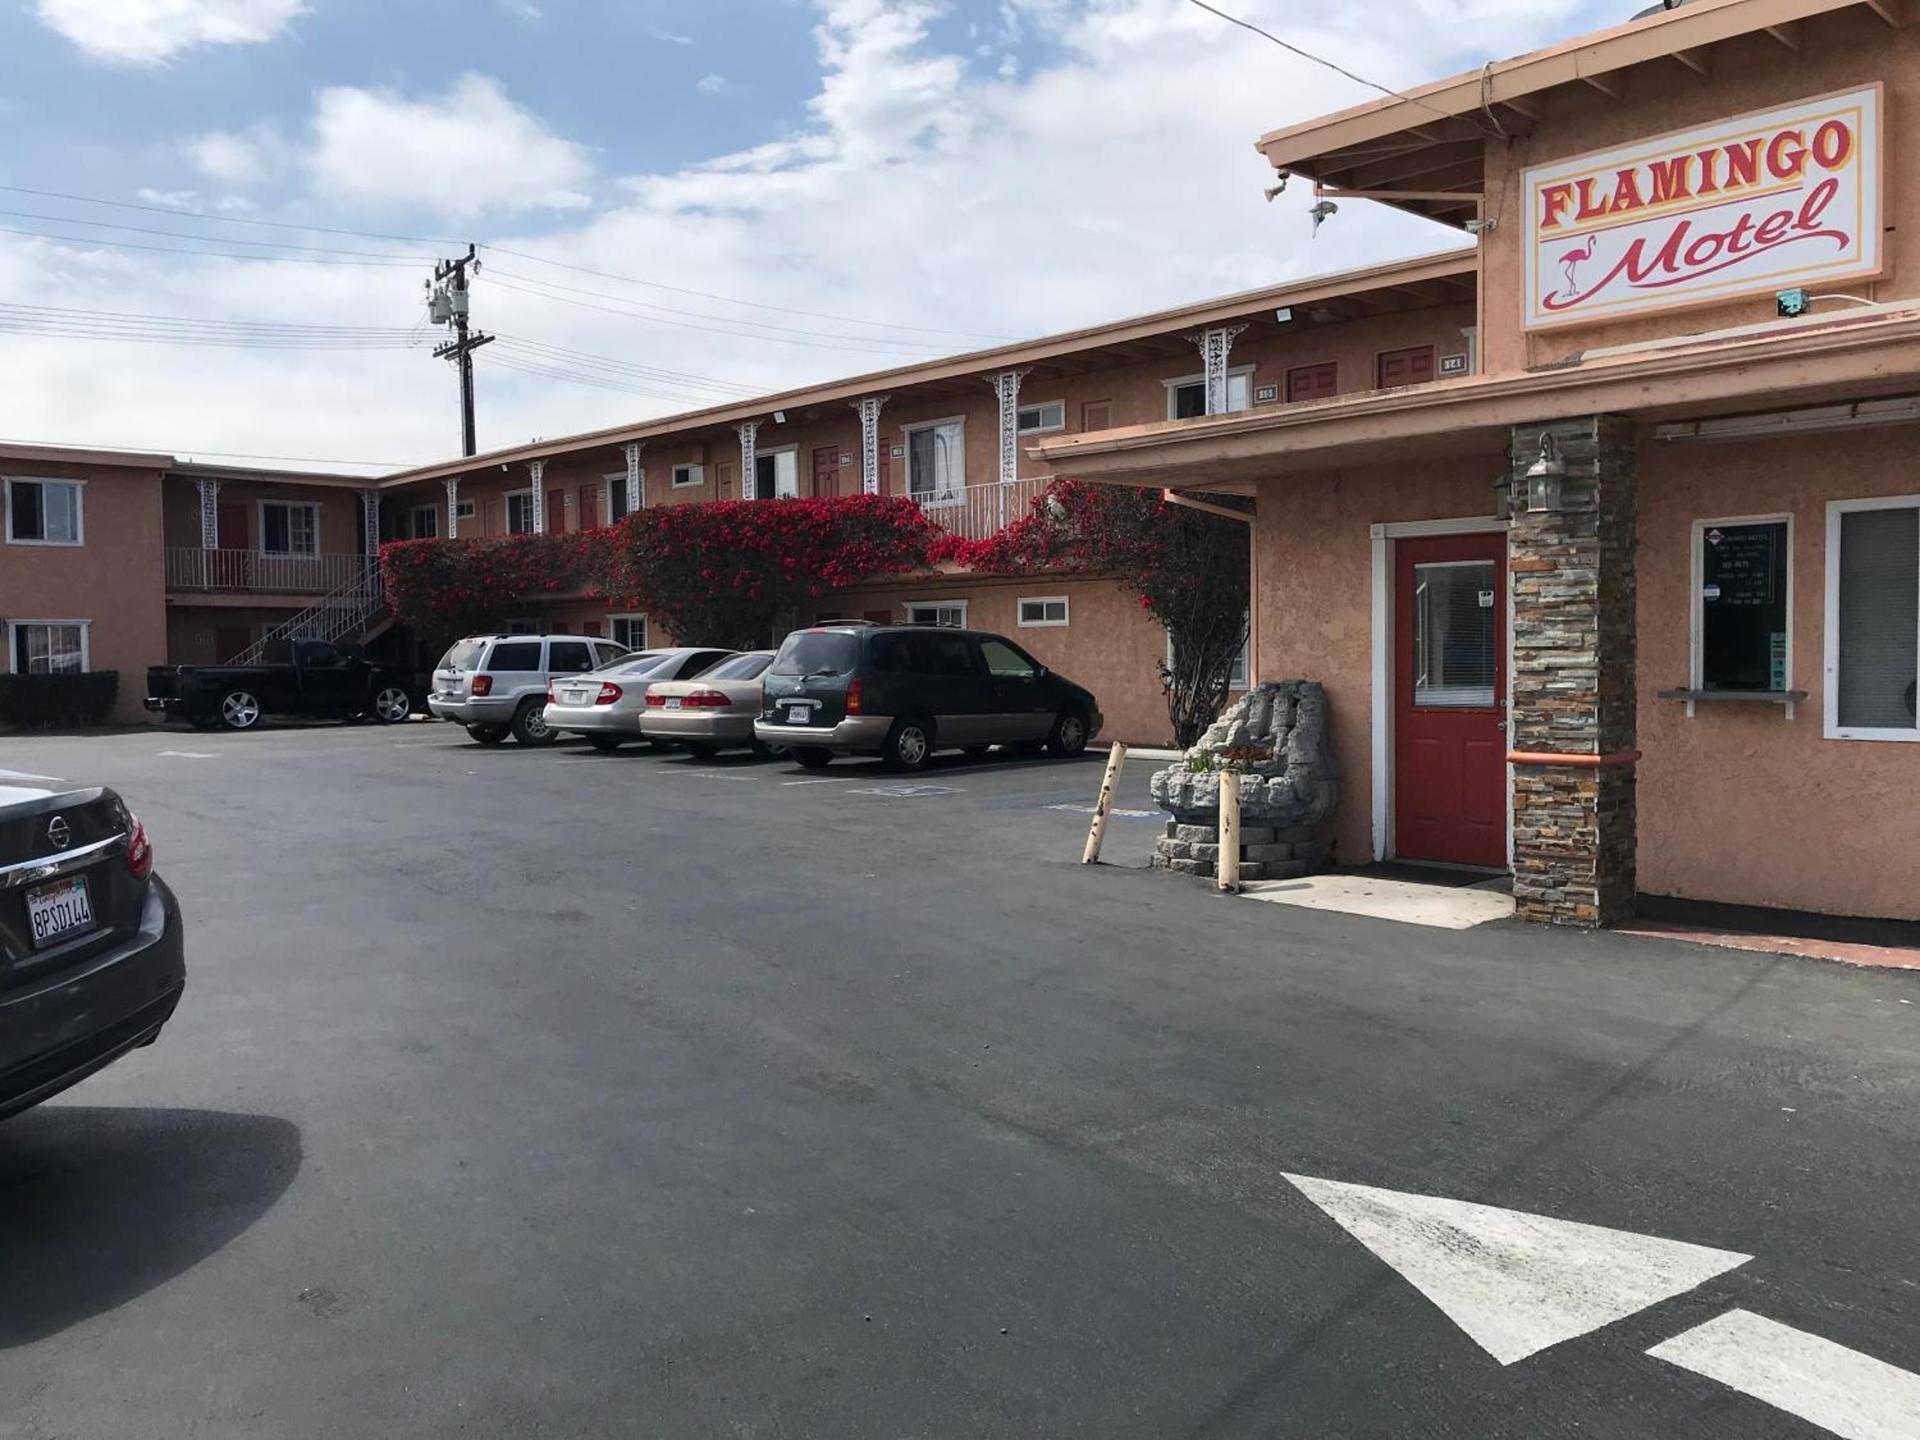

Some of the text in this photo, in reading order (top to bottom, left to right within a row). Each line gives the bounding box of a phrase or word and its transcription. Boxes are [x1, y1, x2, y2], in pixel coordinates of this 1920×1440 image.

[1539, 119, 1855, 230] FLAMINGO
[1543, 177, 1850, 311] Motel
[34, 898, 89, 937] 8PSD144
